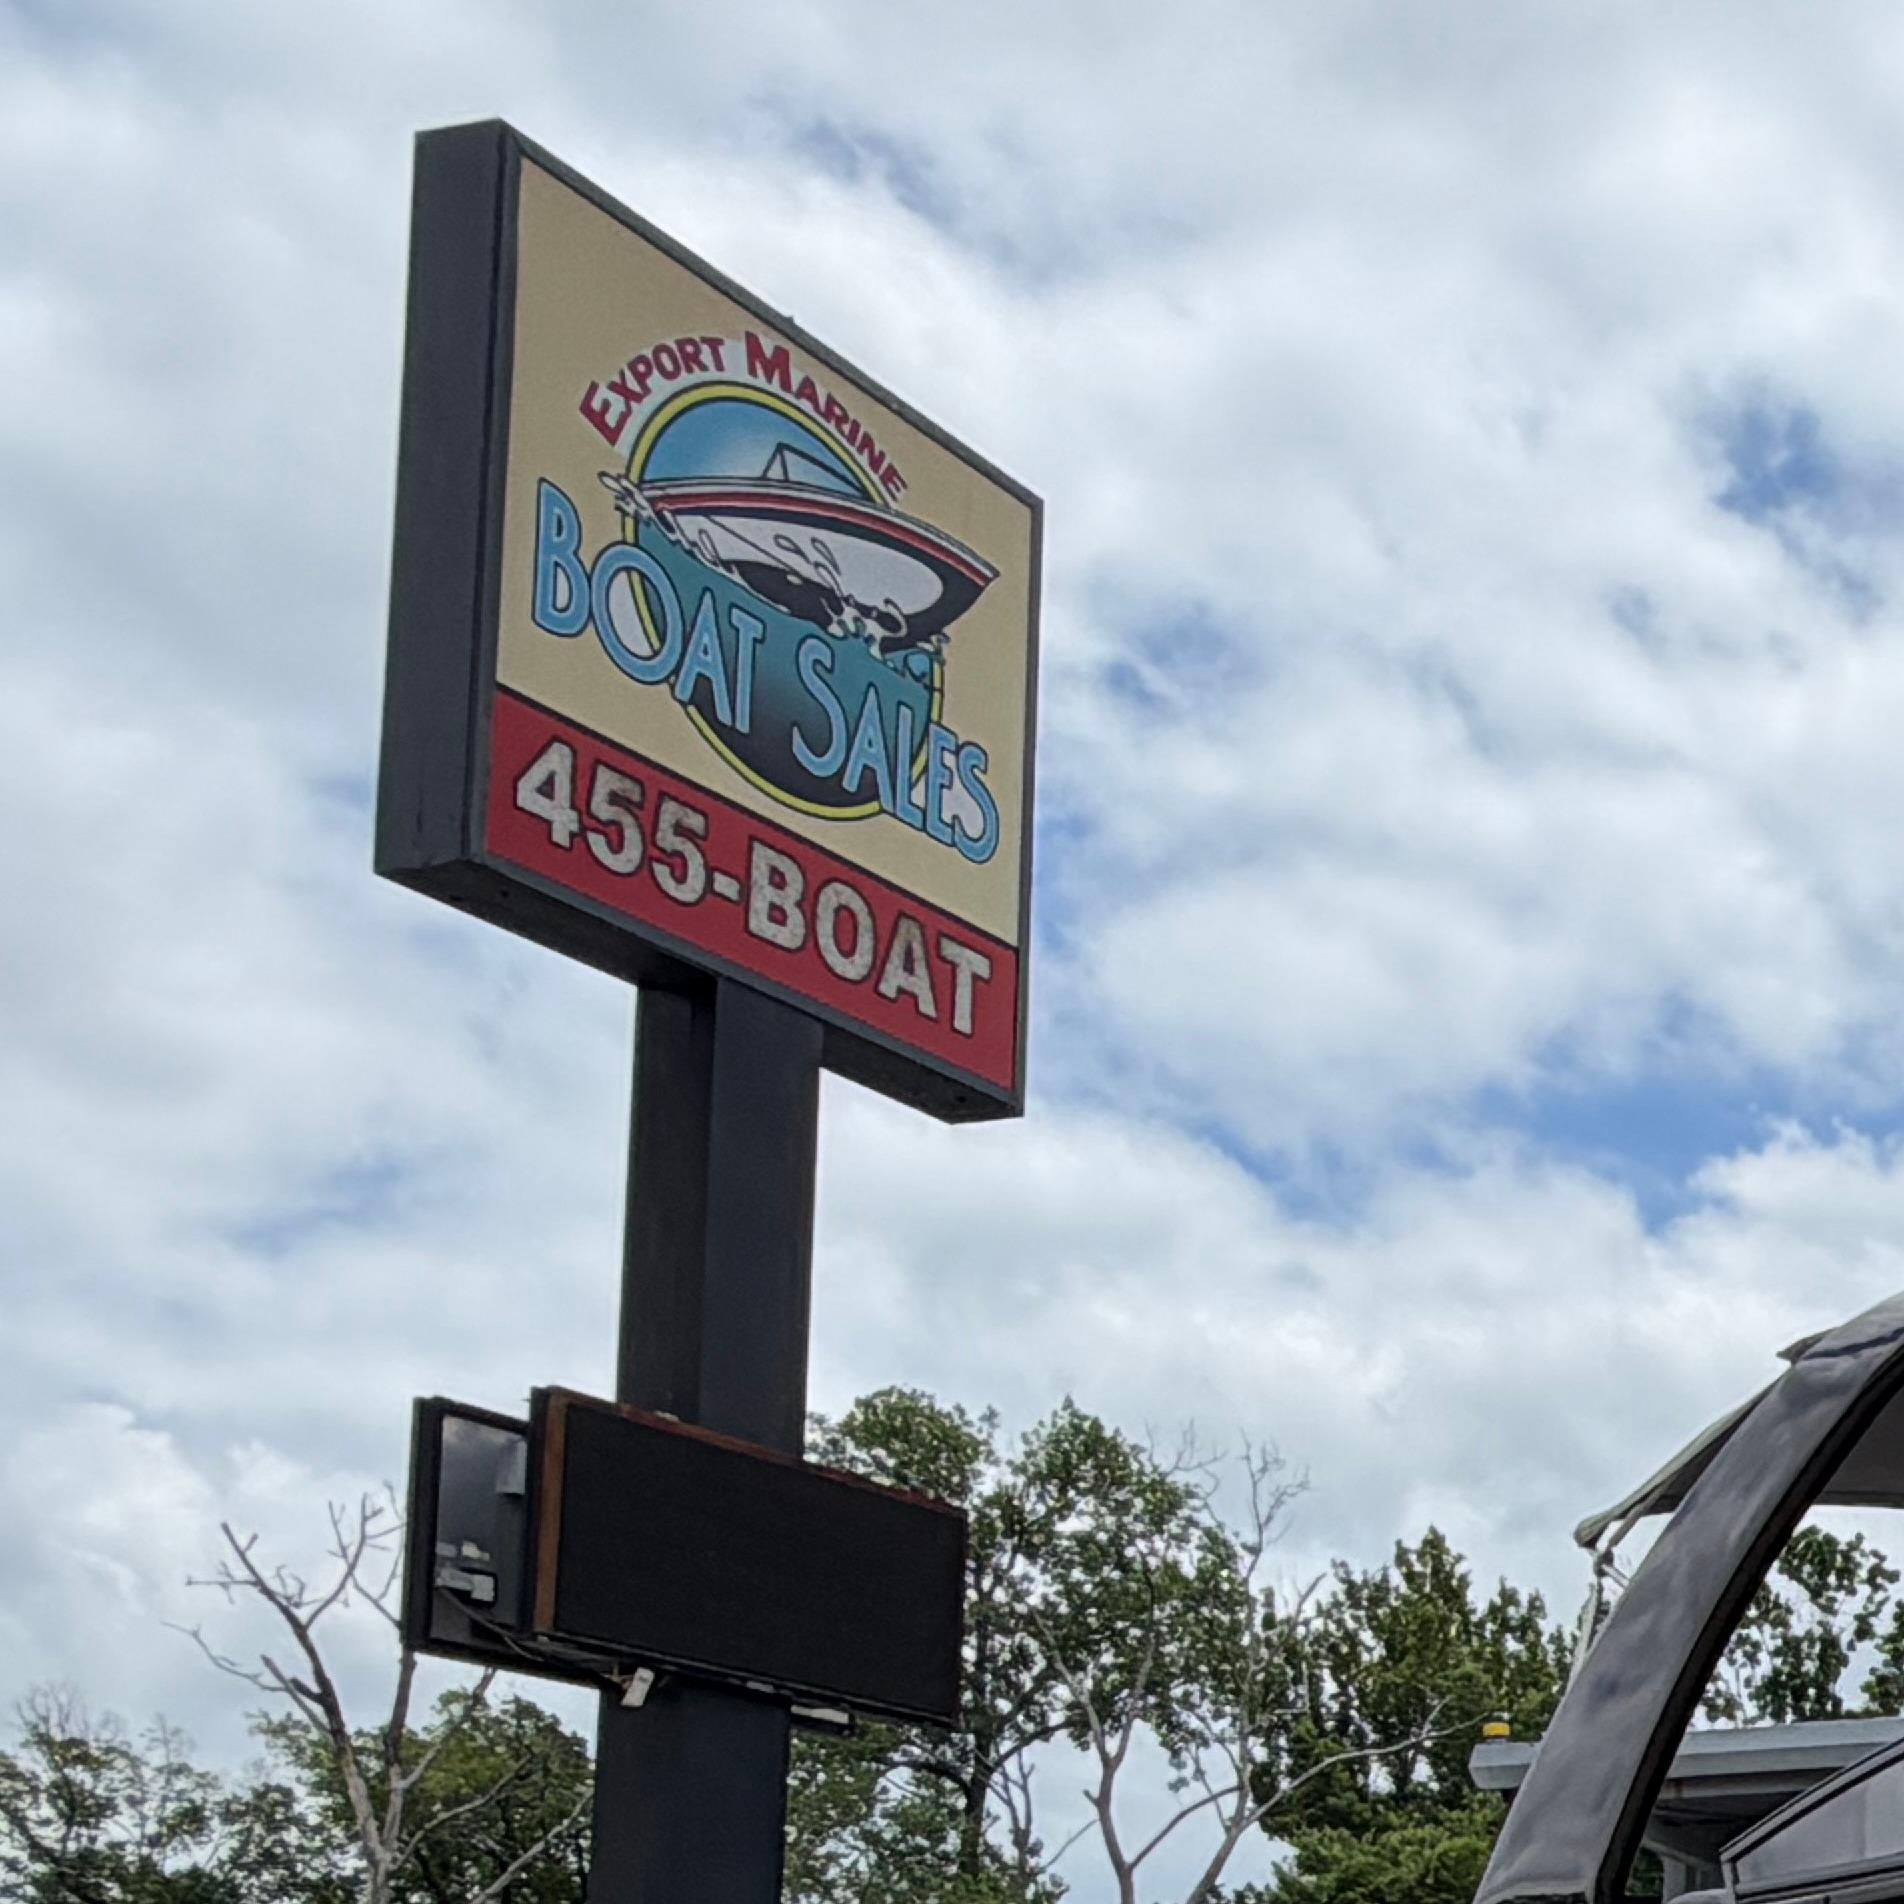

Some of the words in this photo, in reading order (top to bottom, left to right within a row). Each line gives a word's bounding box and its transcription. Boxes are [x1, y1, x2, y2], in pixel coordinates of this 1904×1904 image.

[533, 477, 764, 734] BOAT
[791, 636, 999, 865] SALES
[515, 739, 992, 1037] 455-BOAT
